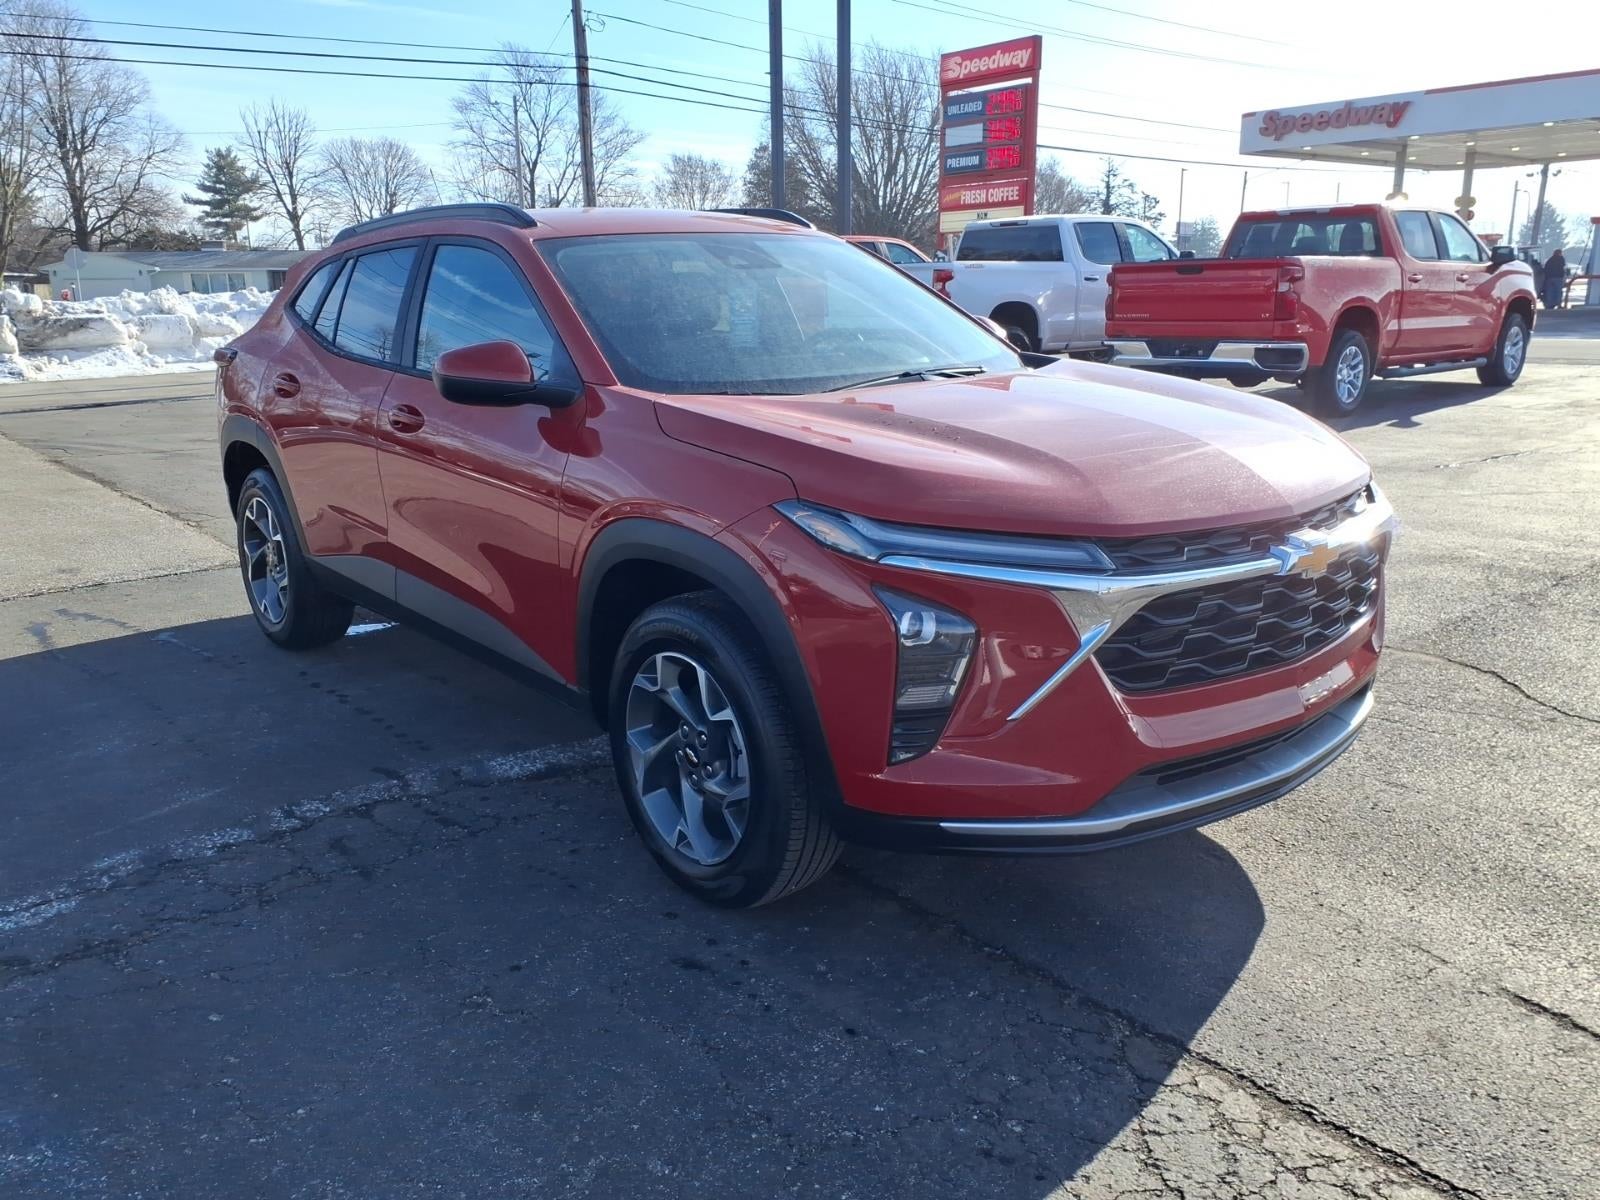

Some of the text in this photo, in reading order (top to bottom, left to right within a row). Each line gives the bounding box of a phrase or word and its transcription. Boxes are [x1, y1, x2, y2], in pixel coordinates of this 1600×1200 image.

[943, 47, 1032, 79] Speedway
[947, 100, 982, 116] UNLEADED
[1259, 100, 1414, 141] Speedway
[947, 155, 979, 169] PREMIUM
[960, 189, 986, 205] FRESH
[988, 186, 1020, 203] COFFEE
